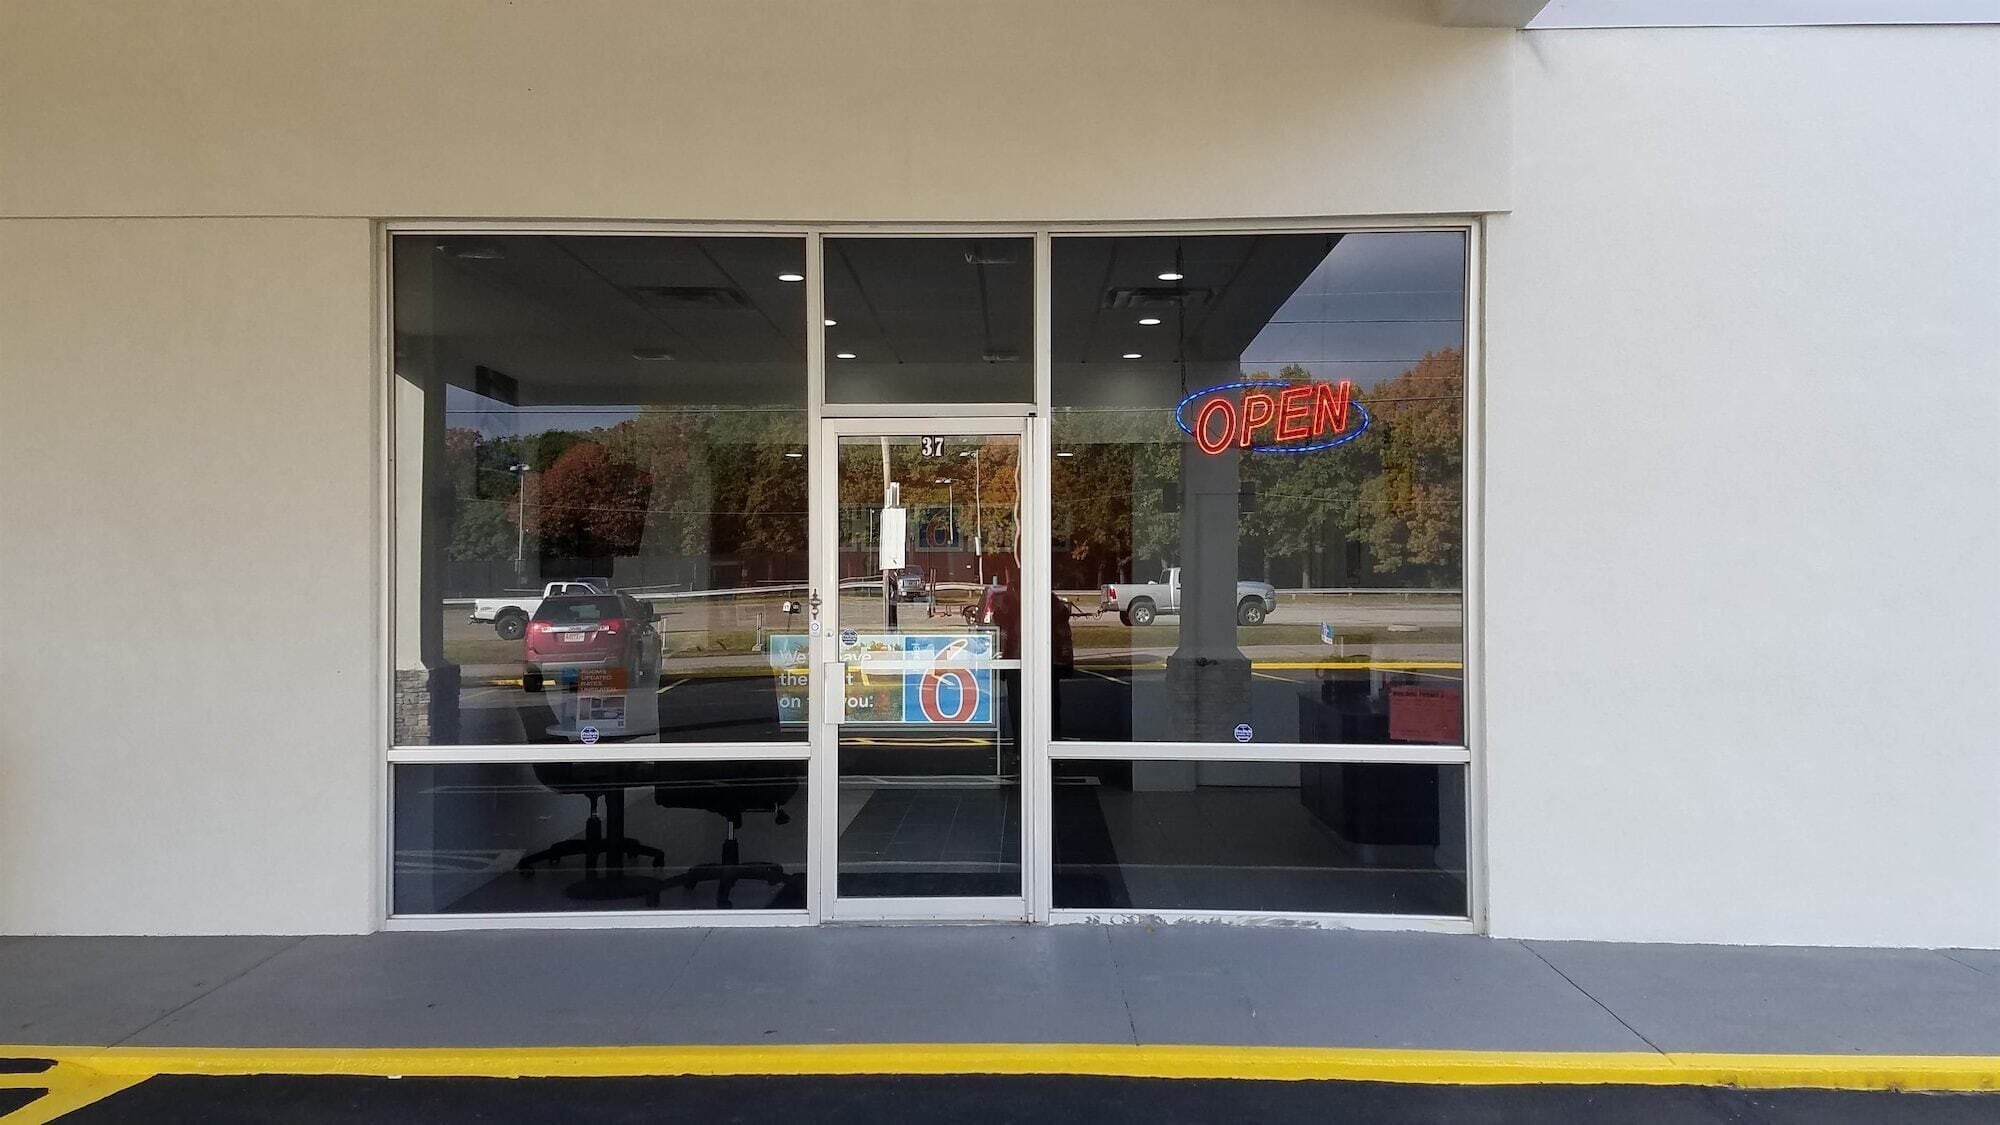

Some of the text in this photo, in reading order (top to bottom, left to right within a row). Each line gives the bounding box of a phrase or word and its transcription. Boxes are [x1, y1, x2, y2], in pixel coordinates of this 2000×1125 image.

[1197, 381, 1350, 454] OPEN
[922, 436, 944, 456] 37
[779, 669, 808, 685] the
[919, 639, 980, 722] 6
[780, 697, 801, 708] on
